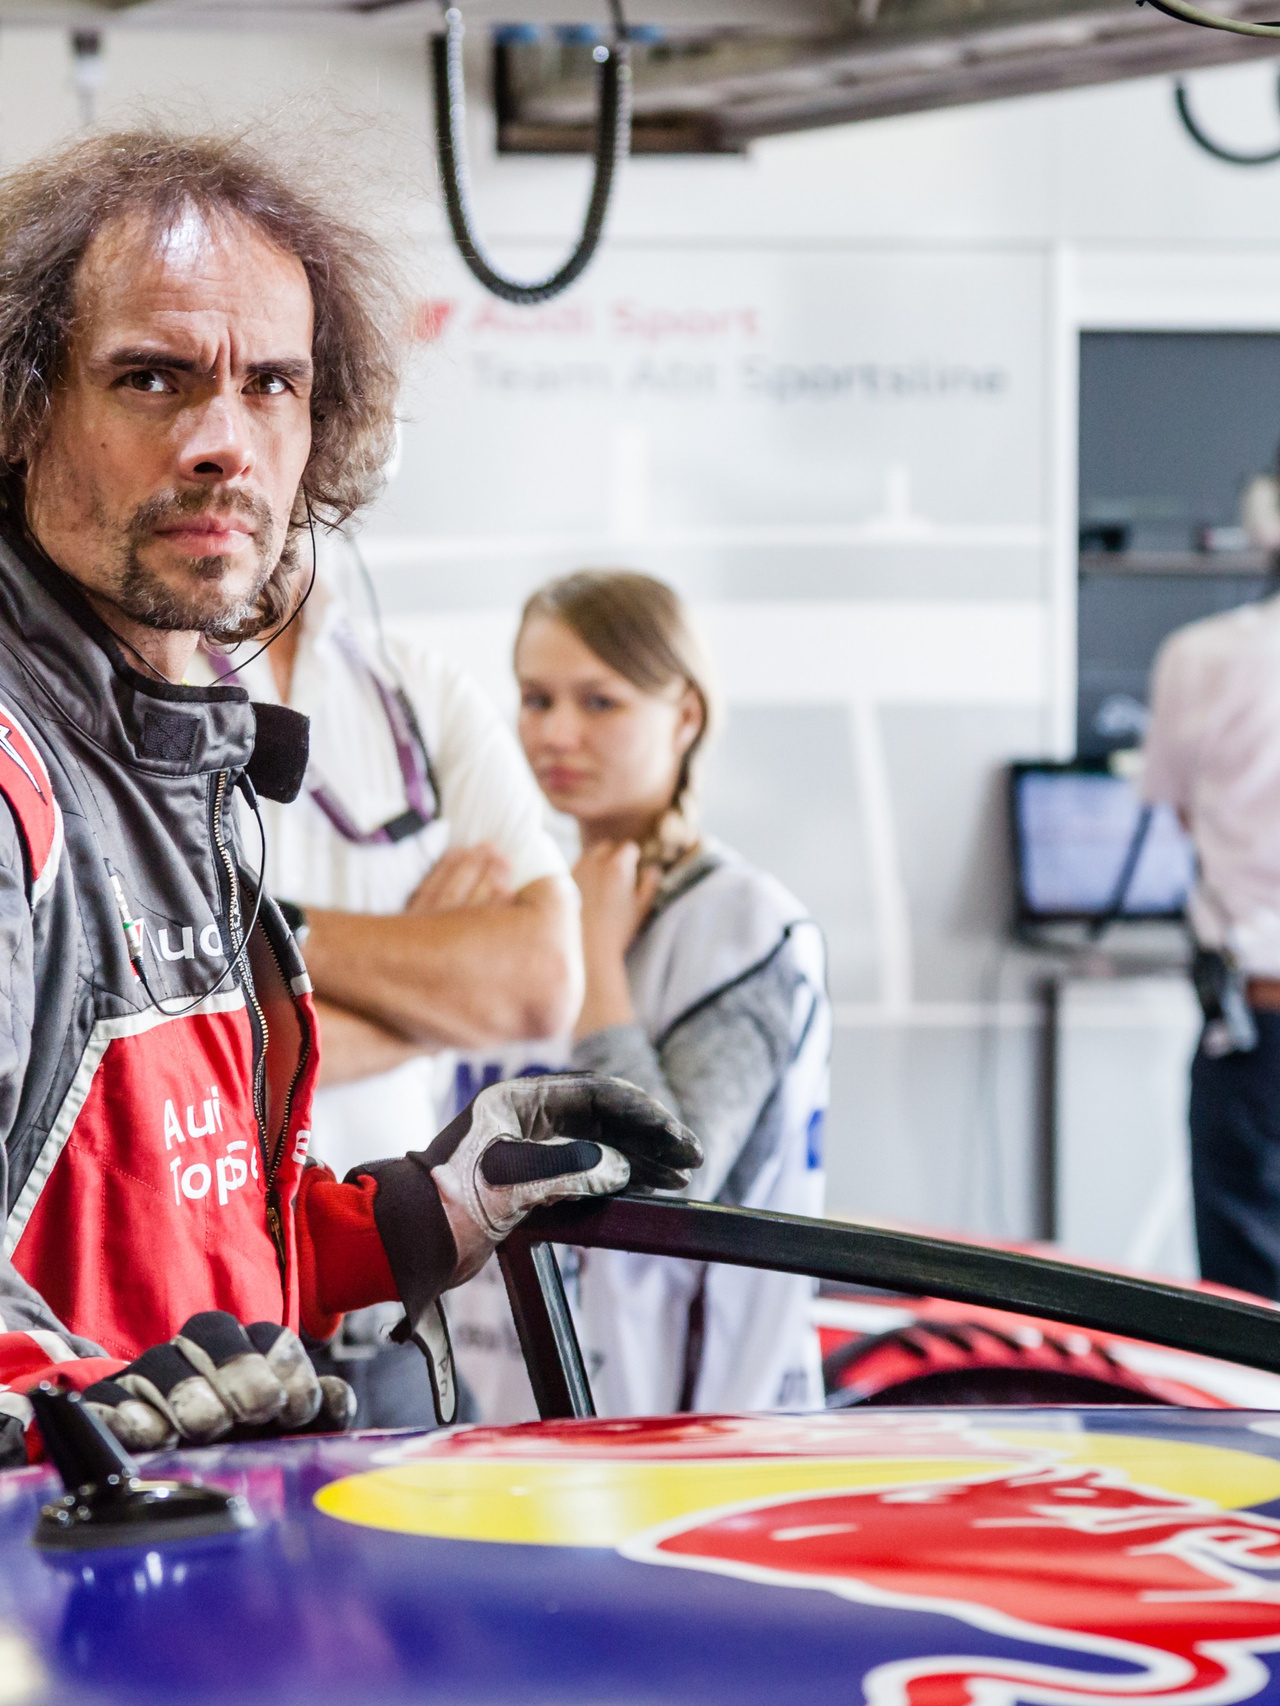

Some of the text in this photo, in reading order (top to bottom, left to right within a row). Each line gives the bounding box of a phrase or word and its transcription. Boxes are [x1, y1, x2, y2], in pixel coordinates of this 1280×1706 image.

[610, 298, 761, 342] Sport
[471, 352, 612, 389] Team
[739, 352, 1010, 402] Sportsline
